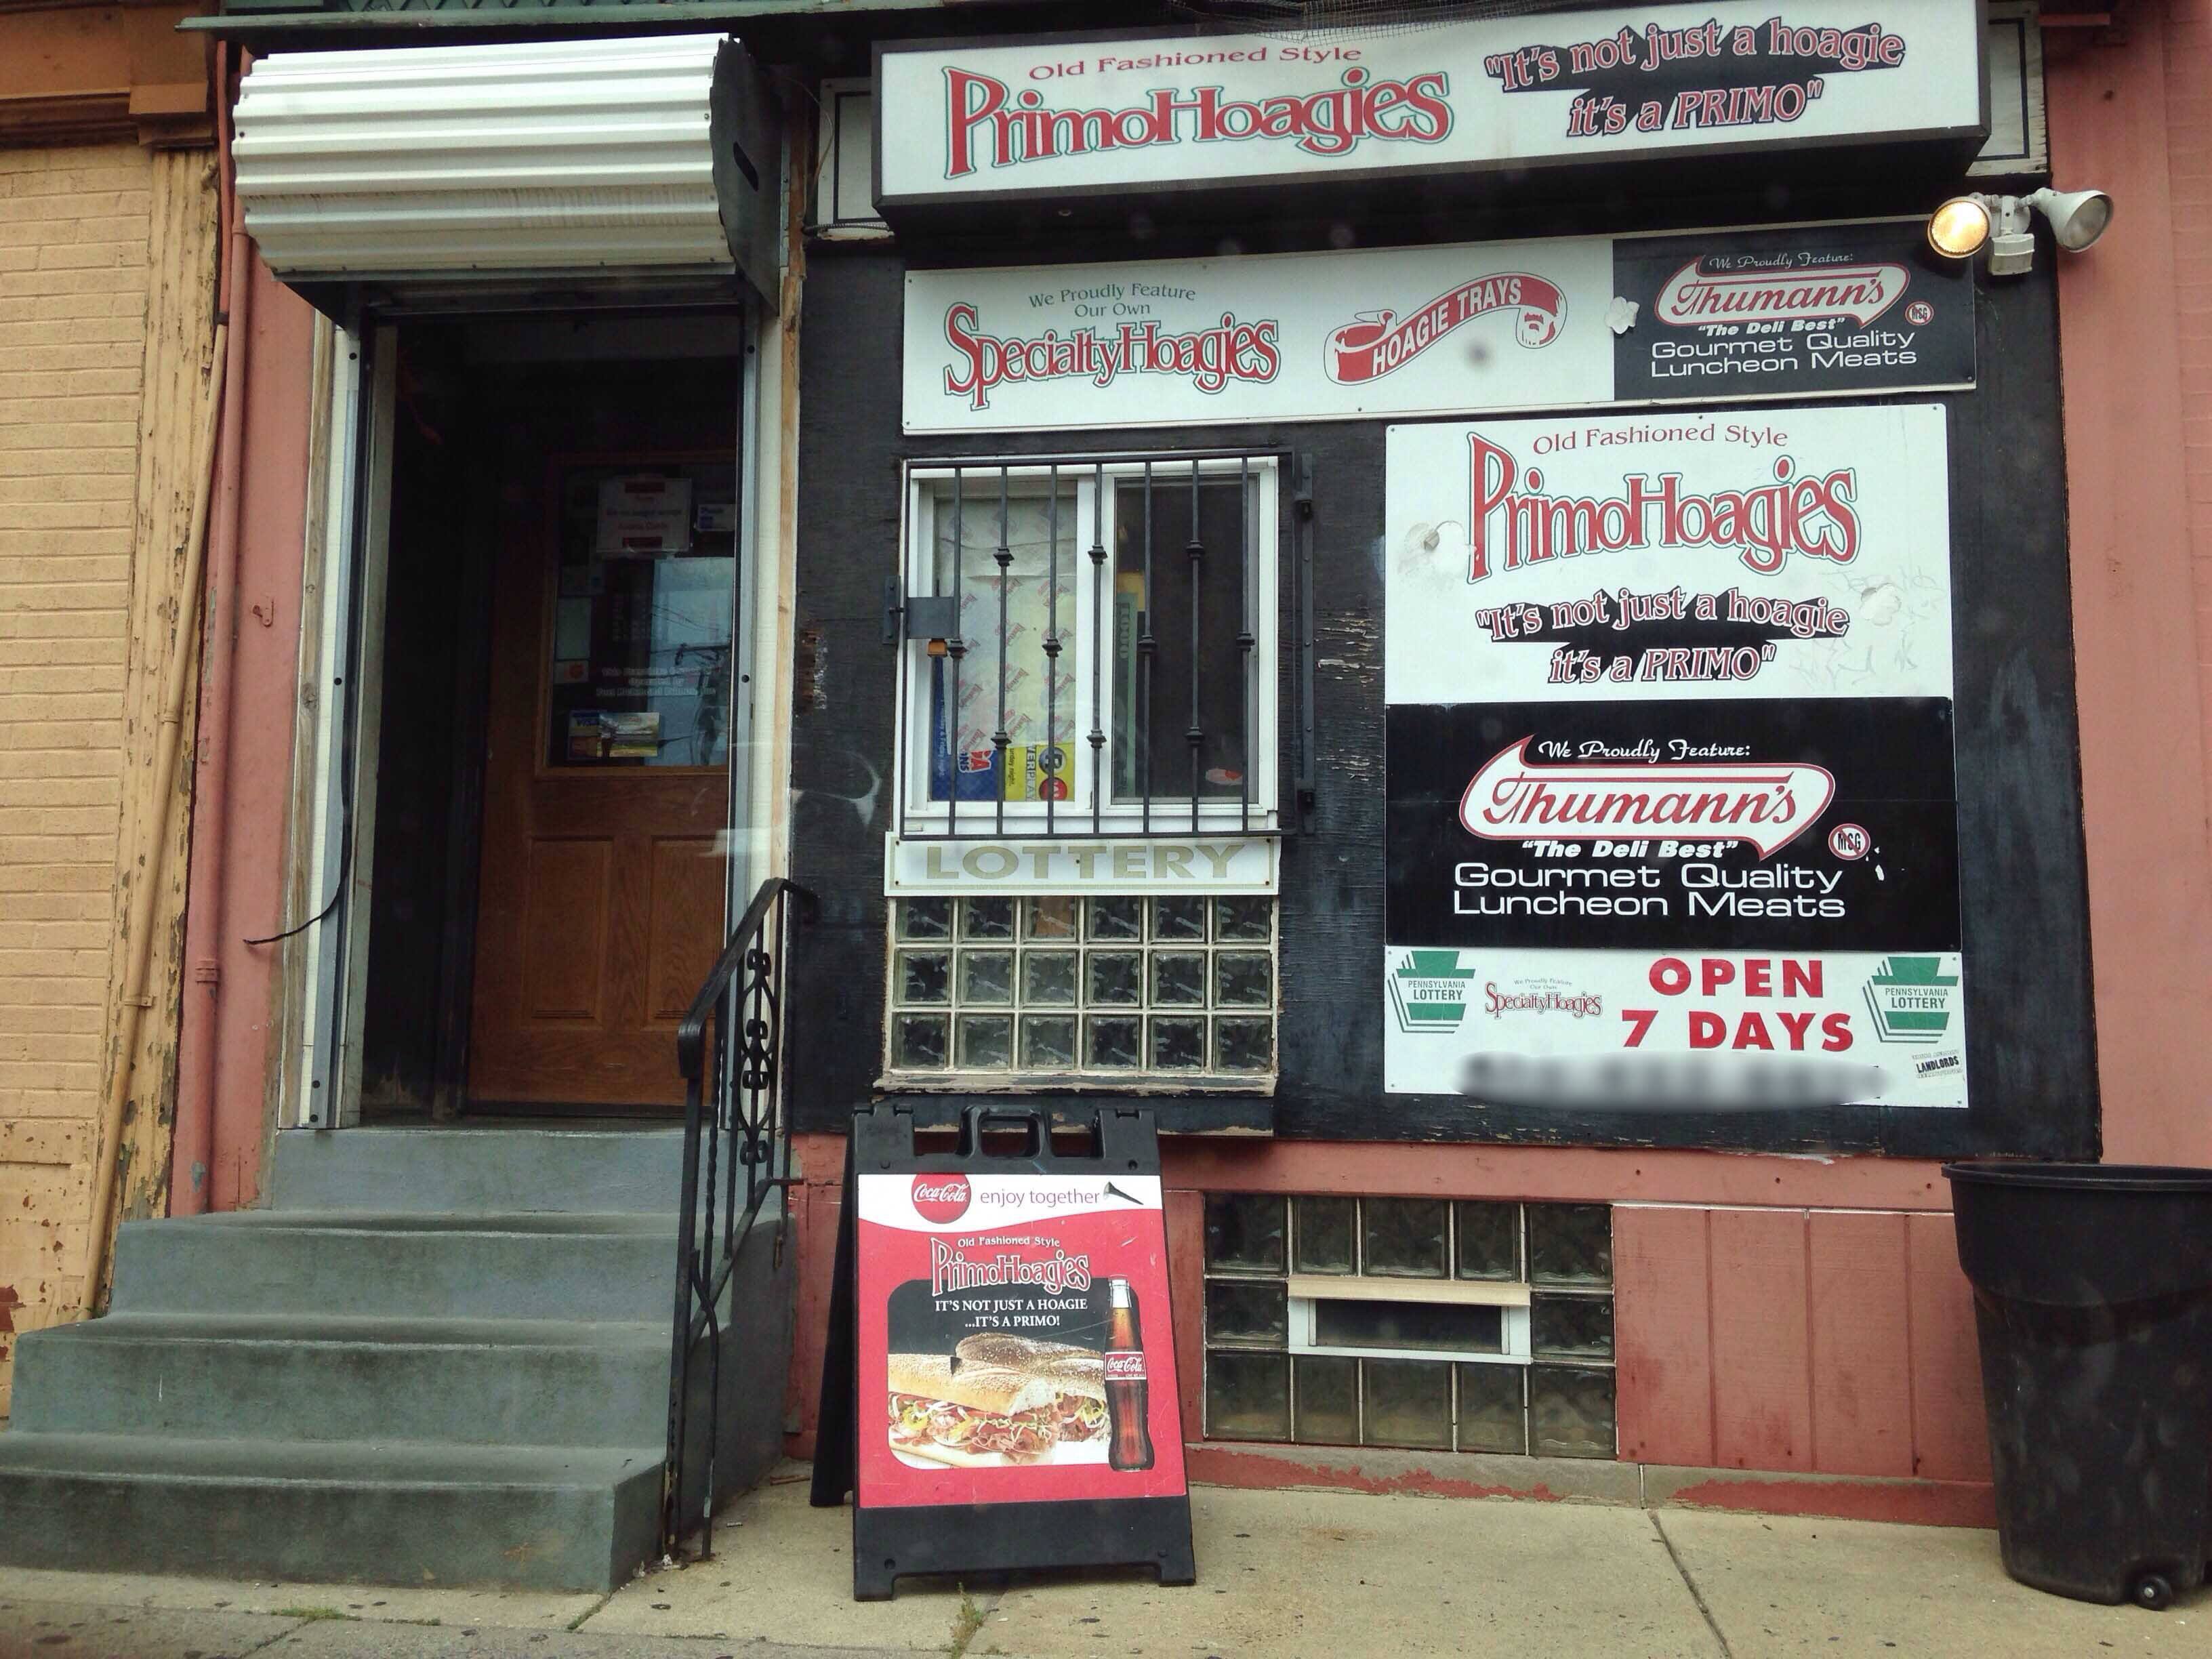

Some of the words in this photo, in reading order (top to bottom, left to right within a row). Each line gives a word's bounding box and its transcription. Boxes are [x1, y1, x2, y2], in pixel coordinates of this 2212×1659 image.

[1029, 61, 1086, 81] Old
[1098, 47, 1267, 72] Fashioned
[1279, 46, 1363, 64] Style
[1484, 46, 1560, 91] "It's
[1571, 33, 1635, 74] not
[1640, 19, 1722, 70] just
[1732, 26, 1755, 56] a
[1769, 16, 1906, 69] hoagie
[943, 66, 1452, 180] PrimoHoagies
[1568, 96, 1627, 137] it's
[1637, 99, 1662, 131] a
[1672, 79, 1824, 129] PRIMO"
[1708, 257, 1733, 270] We
[1737, 253, 1793, 270] Proudly
[1797, 251, 1855, 267] Feature:
[1029, 293, 1054, 308] We
[1060, 283, 1126, 304] Proudly
[1130, 282, 1196, 302] Feature
[1671, 269, 1885, 316] Thumann's
[1074, 302, 1107, 318] Our
[1112, 302, 1151, 316] Own
[1372, 302, 1450, 376] HOAGIE
[1457, 277, 1523, 320] TRAYS
[1698, 324, 1738, 337] "The
[1746, 321, 1785, 335] Deli
[1790, 316, 1846, 332] Best"
[943, 302, 1281, 411] SpecialtyHoagies
[1651, 335, 1793, 359] Gourmet
[1805, 329, 1916, 350] Quality
[1651, 356, 1799, 377] Luncheon
[1811, 348, 1918, 369] Meats
[1533, 432, 1577, 455] Old
[1586, 424, 1717, 448] Fashioned
[1725, 425, 1788, 448] Style
[1467, 431, 1862, 583] PrimoHoagies
[1475, 600, 1543, 642] "It's
[1551, 589, 1610, 629] not
[1614, 586, 1687, 631] just
[1694, 592, 1716, 620] a
[1727, 586, 1851, 639] hoagie
[1549, 647, 1603, 684] it's
[1610, 653, 1633, 682] a
[1642, 643, 1778, 683] PRIMO"
[1538, 741, 1572, 760] We
[1578, 739, 1662, 764] Proudly
[1668, 738, 1752, 762] Feature:
[1482, 770, 1797, 827] Thumann's
[1521, 840, 1583, 859] "The
[1593, 840, 1649, 859] Deli
[1657, 840, 1740, 859] Best"
[1836, 831, 1862, 852] MSG
[926, 844, 1246, 880] LOTTERY
[1454, 862, 1660, 888] Gourmet
[1681, 862, 1843, 895] Quality
[1454, 890, 1669, 917] Luncheon
[1687, 891, 1846, 918] Meats
[1408, 980, 1467, 989] PENNSYLVANIA
[1648, 957, 1824, 998] OPEN
[1885, 987, 1949, 997] PENNSYLVANIA
[1413, 989, 1463, 1001] LOTTERY
[1485, 981, 1603, 1020] SpecialtyHoagies
[1891, 997, 1946, 1009] LOTTERY
[1622, 1009, 1659, 1048] 7
[1688, 1010, 1853, 1052] DAYS
[1916, 1055, 1960, 1075] LANDLORDS
[913, 1182, 968, 1204] Coca-Cola
[980, 1191, 1025, 1208] enjoy
[1029, 1191, 1101, 1208] together
[957, 1237, 976, 1248] Old
[979, 1236, 1031, 1247] Fashioned
[1034, 1236, 1061, 1248] Style
[930, 1237, 1091, 1297] PrimoHoagies
[935, 1300, 960, 1313] IT'S
[962, 1300, 992, 1312] NOT
[994, 1299, 1024, 1312] JUST
[1026, 1299, 1036, 1311] A
[1038, 1298, 1088, 1311] HOAGIE
[1002, 1315, 1011, 1327] A
[1013, 1315, 1061, 1328] PRIMO!
